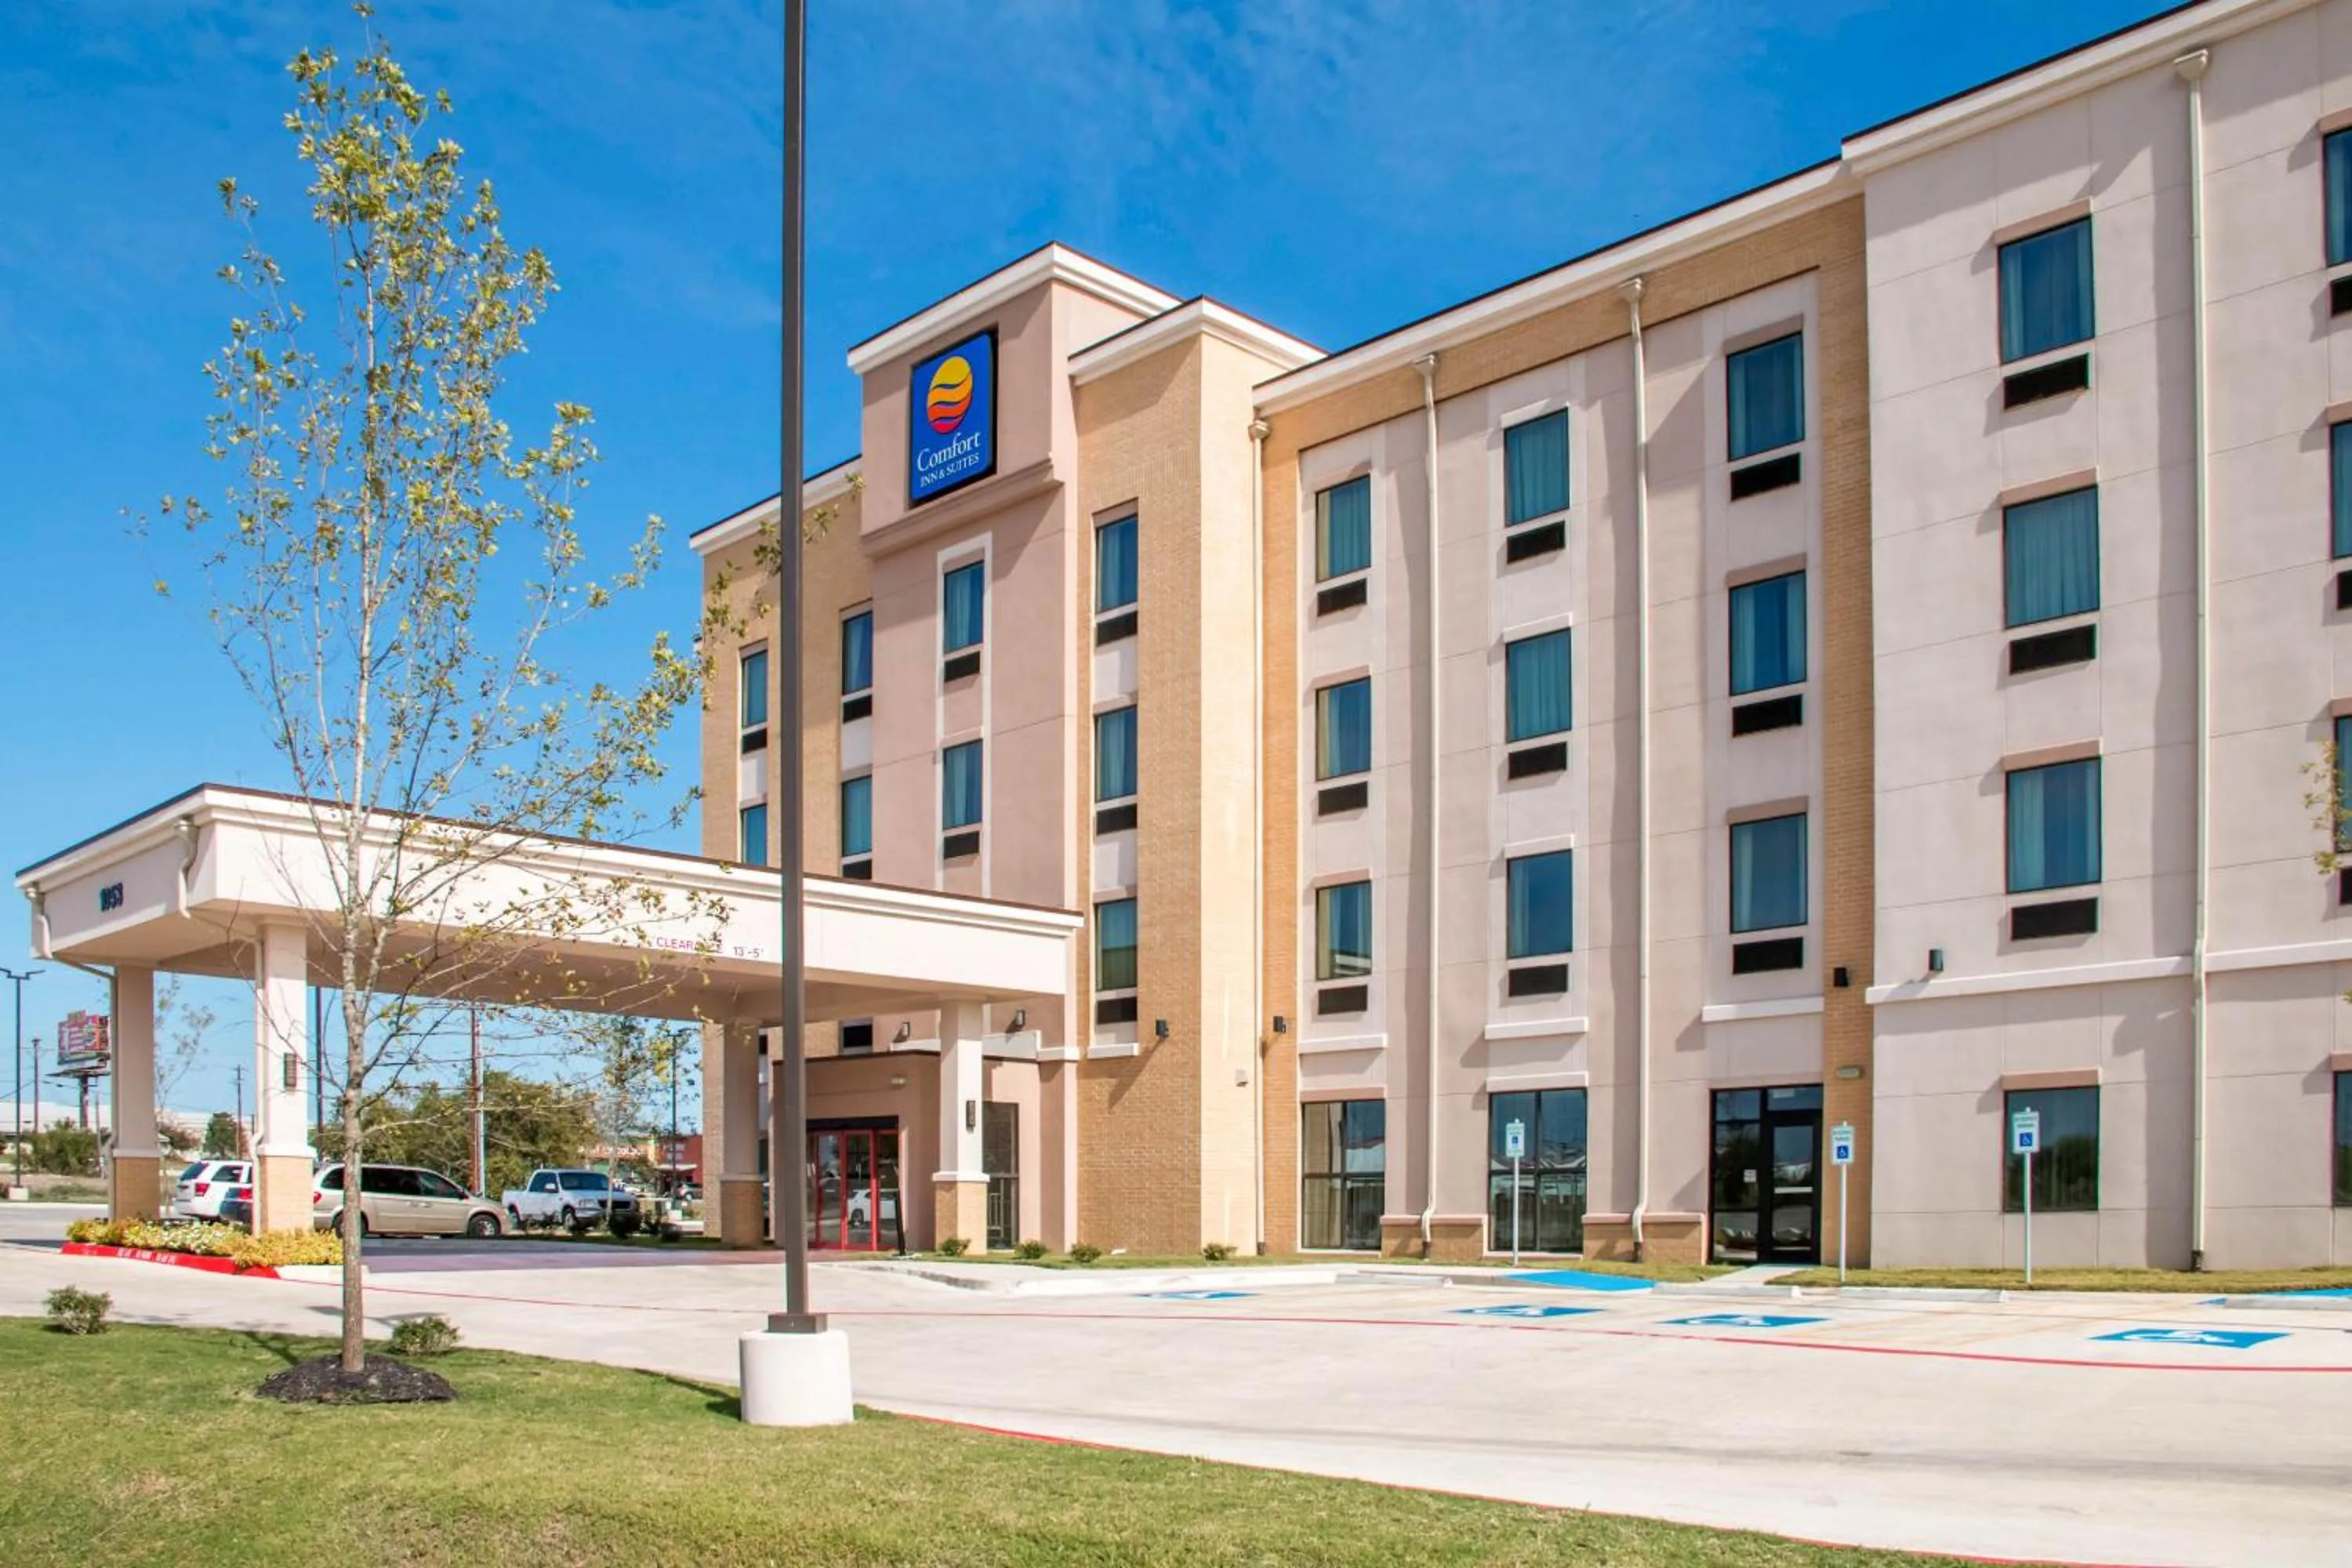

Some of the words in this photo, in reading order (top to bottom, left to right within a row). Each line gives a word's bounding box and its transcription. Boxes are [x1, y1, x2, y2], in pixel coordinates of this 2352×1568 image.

[917, 432, 981, 471] Comfort
[920, 470, 938, 488] INN
[946, 452, 979, 476] SUITES
